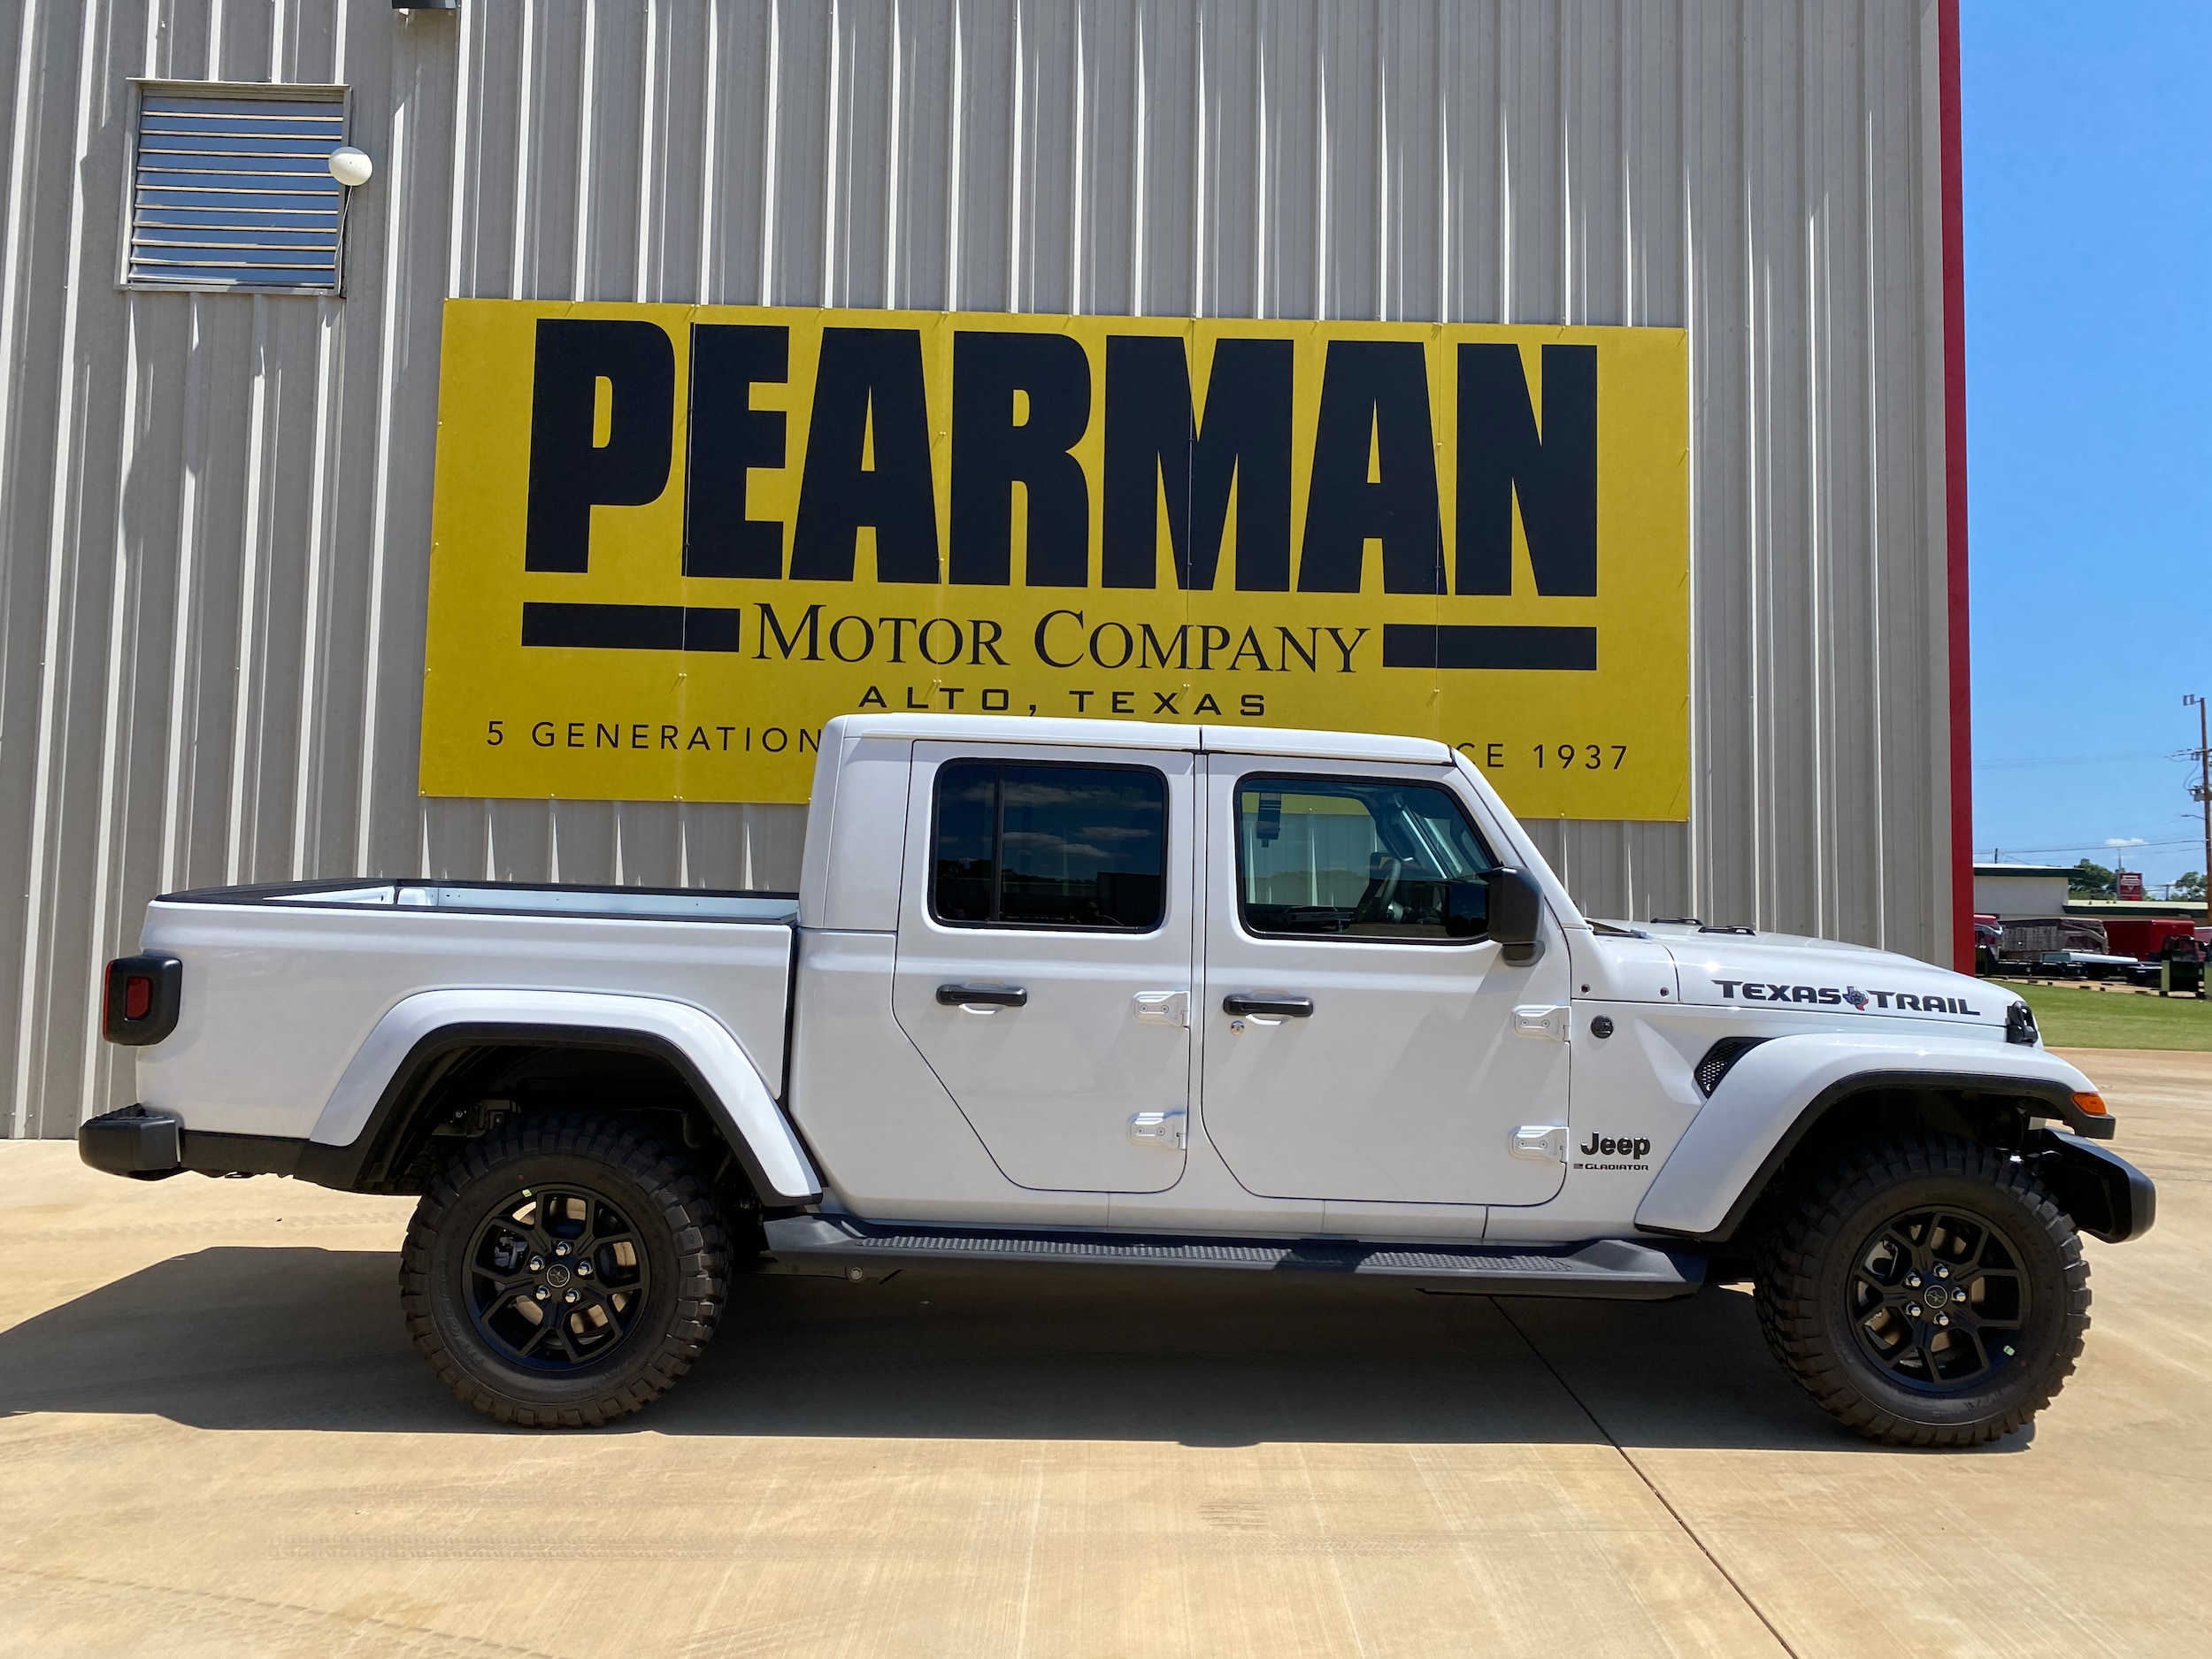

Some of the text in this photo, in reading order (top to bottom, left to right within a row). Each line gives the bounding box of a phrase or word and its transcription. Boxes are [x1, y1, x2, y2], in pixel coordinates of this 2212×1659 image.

[525, 318, 1598, 597] PEARMAN
[750, 602, 1371, 673] MOTOR COMPANY
[858, 686, 1265, 718] ALTO, TEXAS
[486, 720, 503, 746] 5
[1532, 744, 1627, 770] 1937
[1711, 979, 1981, 1016] TEXAS TRAIL
[1580, 1131, 1651, 1160] Jeep
[1584, 1163, 1649, 1171] GLADIATOR
